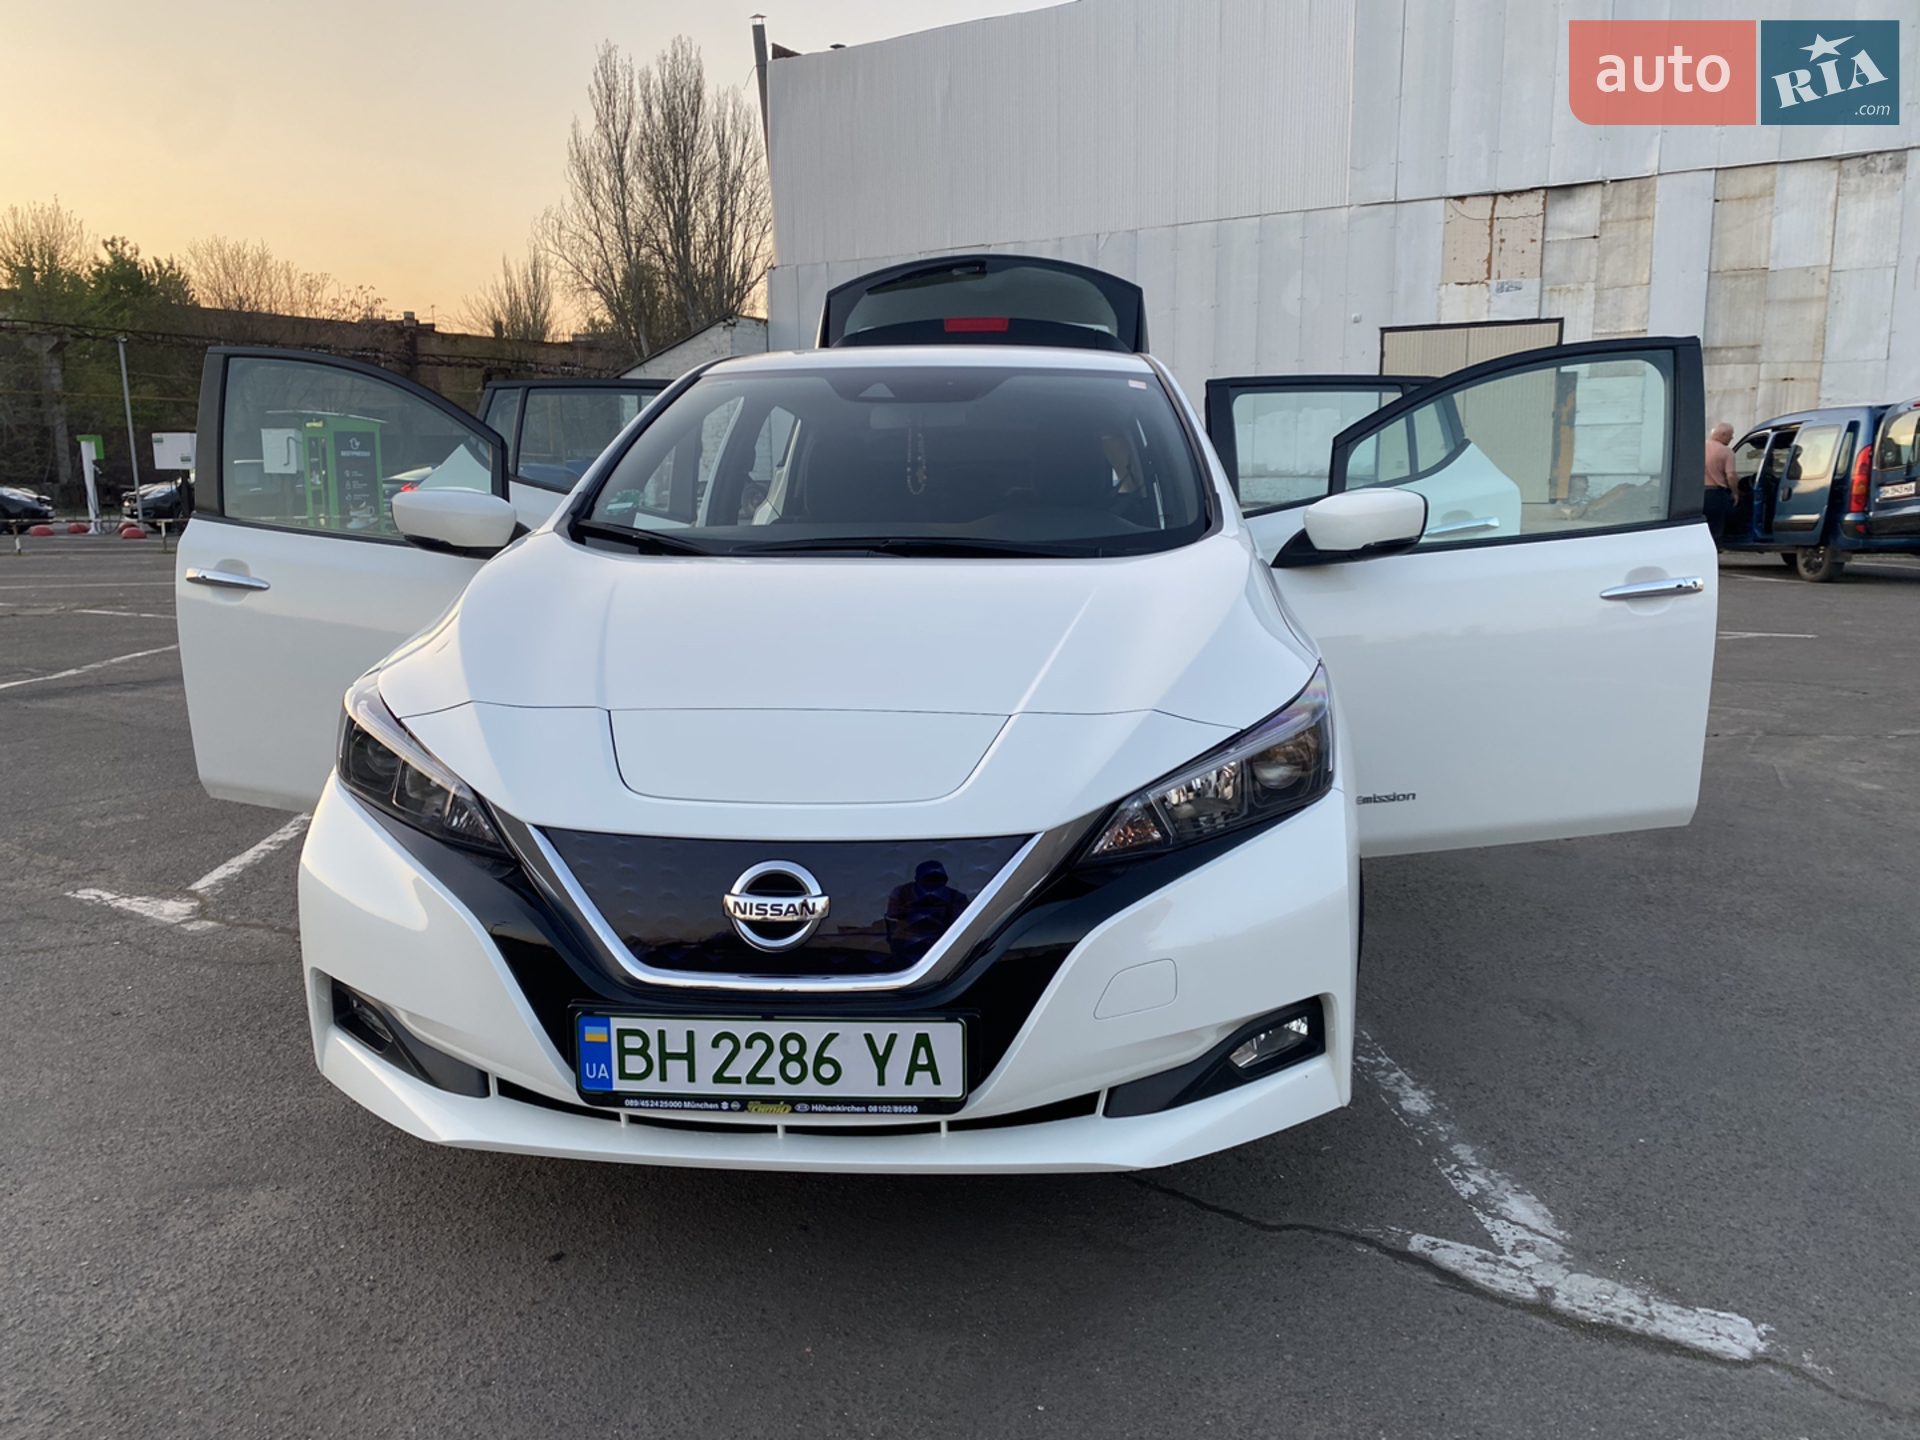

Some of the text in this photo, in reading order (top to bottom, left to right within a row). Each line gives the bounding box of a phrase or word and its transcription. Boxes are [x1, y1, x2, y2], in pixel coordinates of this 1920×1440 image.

[732, 900, 816, 917] NISSAN
[616, 1027, 942, 1087] BH 2286 YA
[585, 1063, 610, 1080] UA
[683, 1100, 719, 1110] München
[811, 1103, 866, 1113] Höhenkirchen
